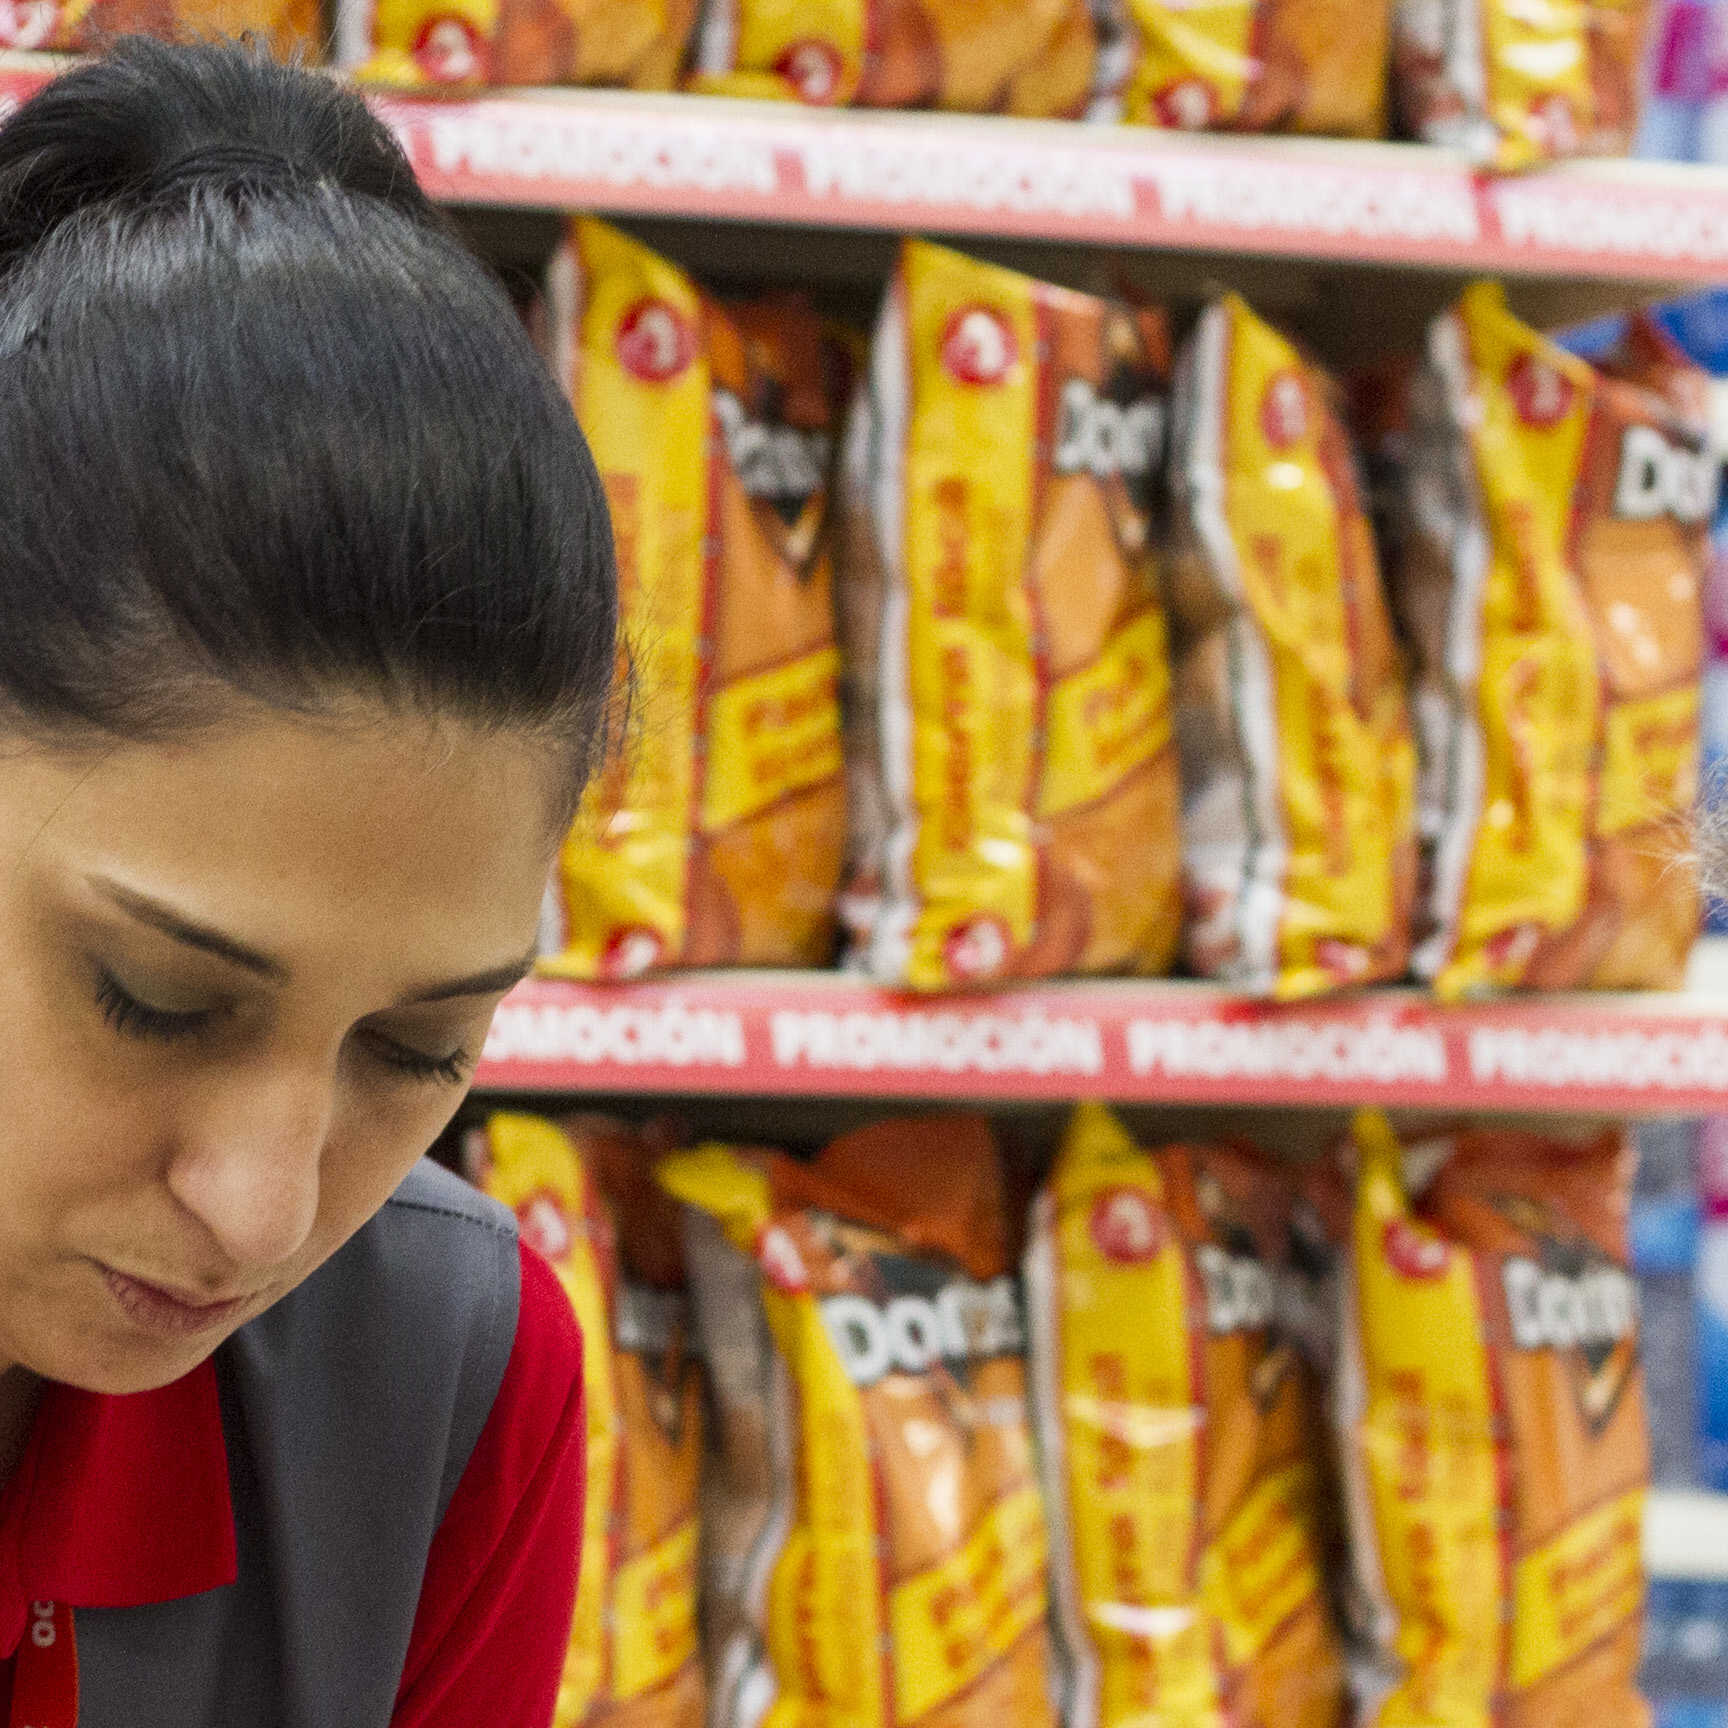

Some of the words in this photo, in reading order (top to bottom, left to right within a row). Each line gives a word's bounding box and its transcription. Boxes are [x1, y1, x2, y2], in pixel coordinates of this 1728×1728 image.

[430, 112, 774, 196] PROMOCIÓN
[1162, 150, 1478, 242] PROMOCIÓN
[772, 998, 1103, 1074] PROMOCIÓN
[1126, 1005, 1448, 1084] PROMOCIÓN
